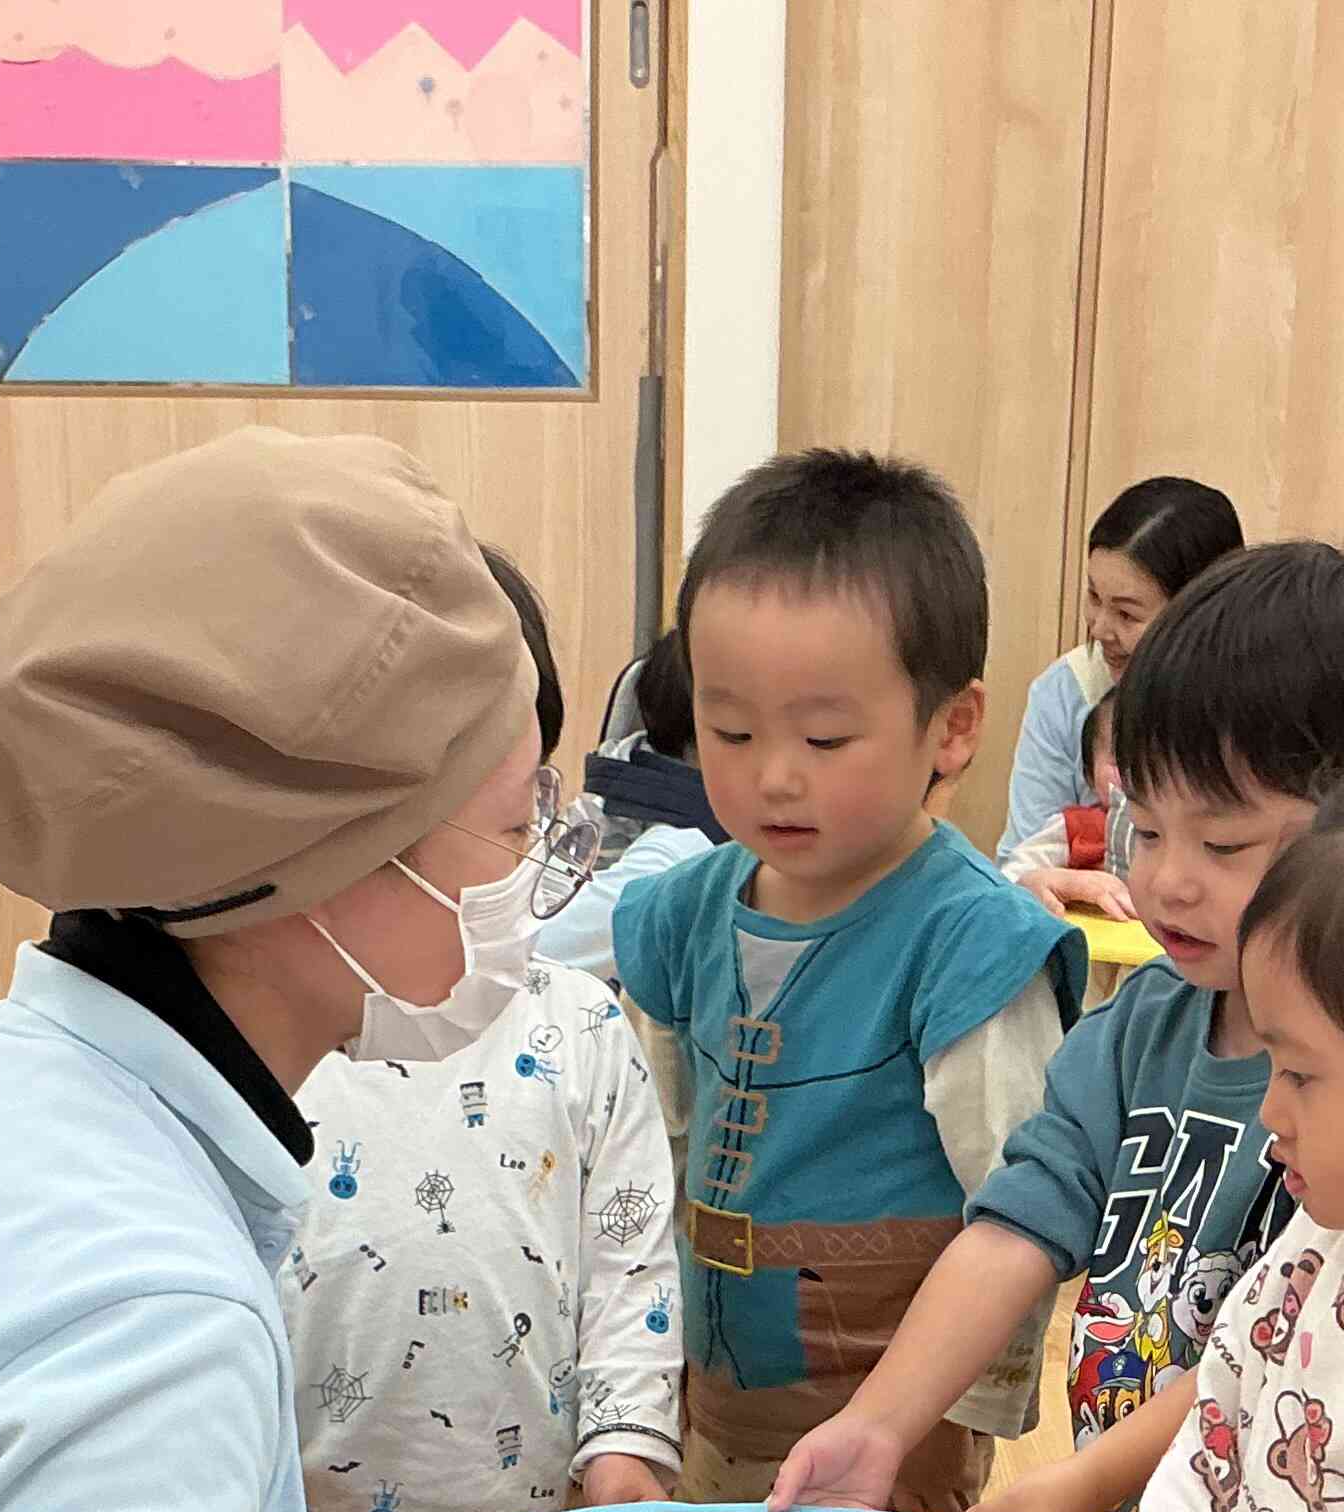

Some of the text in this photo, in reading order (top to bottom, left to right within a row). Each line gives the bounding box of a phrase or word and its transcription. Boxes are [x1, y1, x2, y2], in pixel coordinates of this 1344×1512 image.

[499, 1152, 527, 1171] Lee
[358, 1243, 387, 1273] Lee
[401, 1339, 426, 1370] Lee
[530, 1485, 555, 1498] Lee
